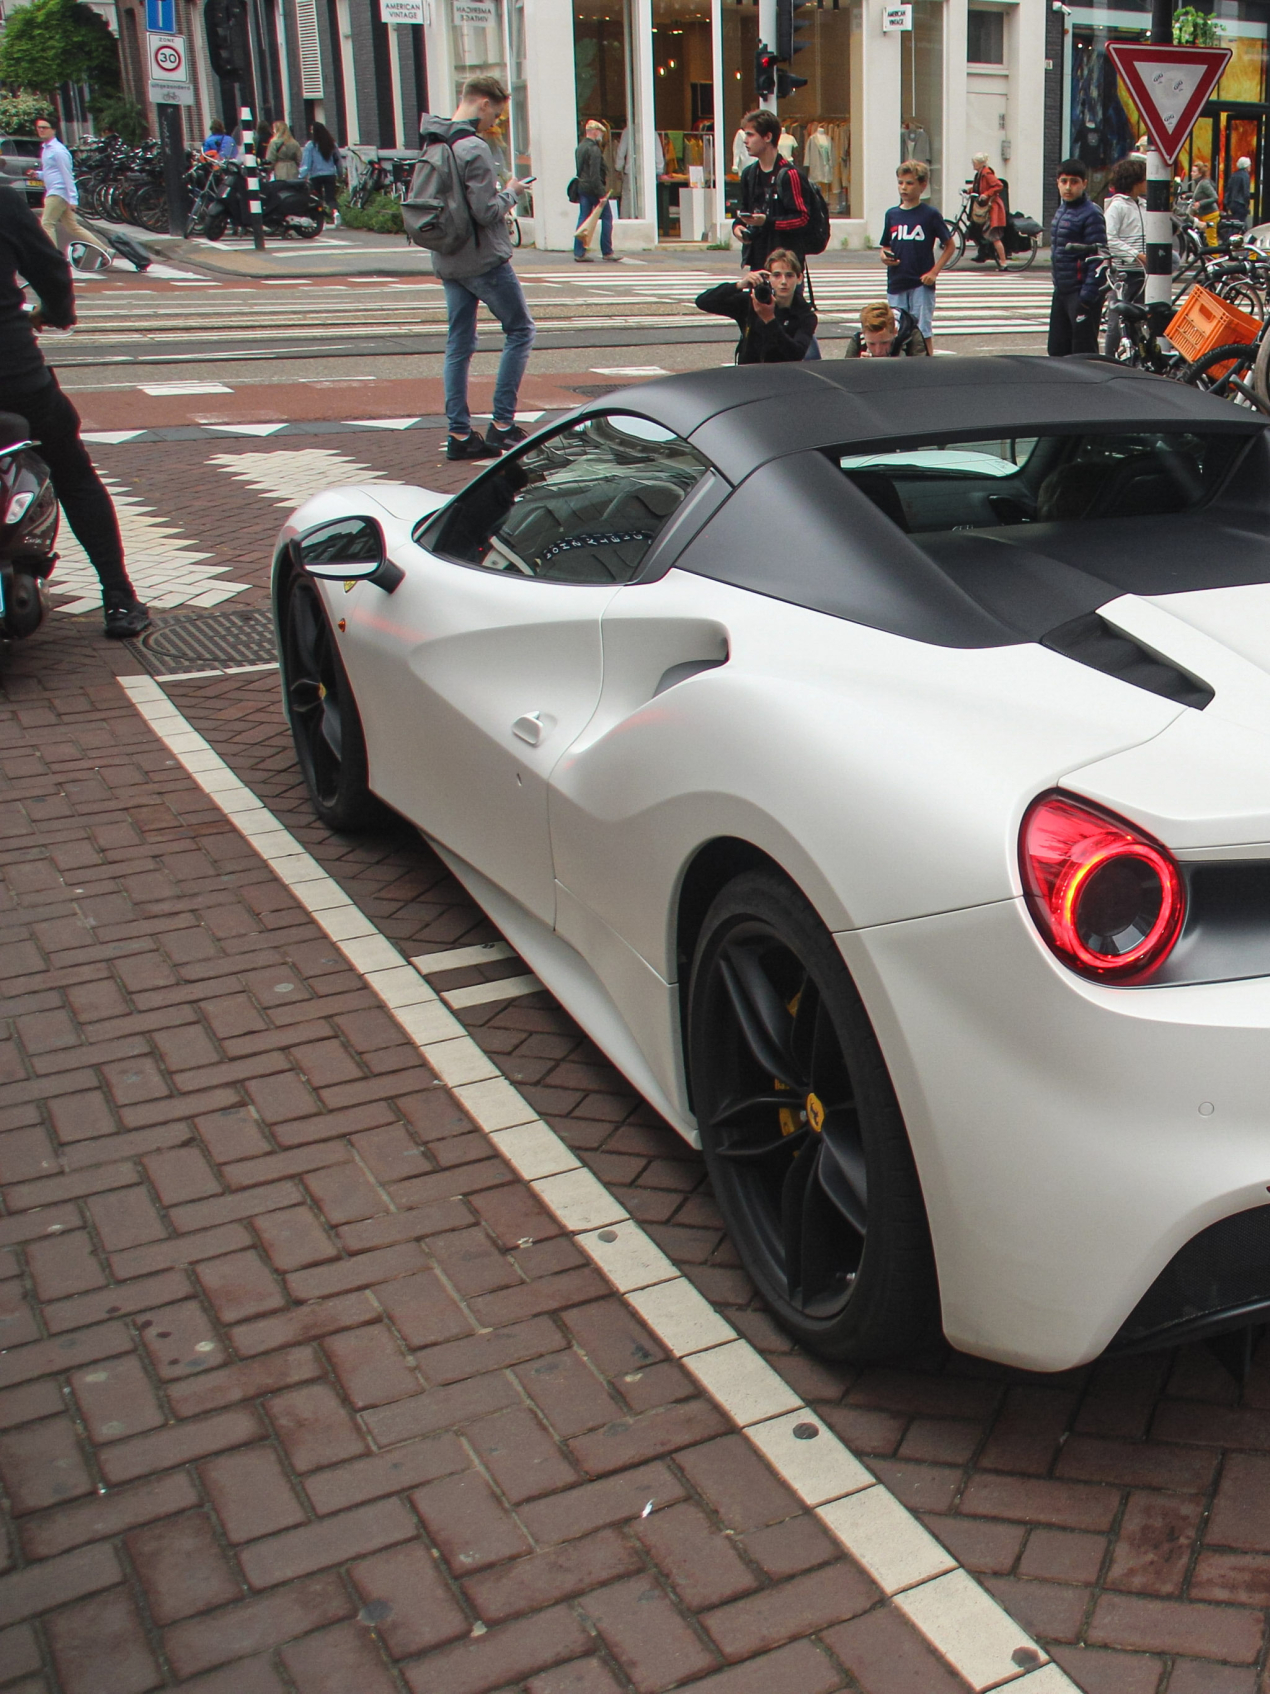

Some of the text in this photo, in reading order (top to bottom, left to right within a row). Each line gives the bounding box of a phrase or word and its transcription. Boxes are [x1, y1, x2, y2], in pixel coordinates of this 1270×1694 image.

[385, 3, 420, 11] AMERICAN
[389, 11, 417, 19] VINTAGE
[159, 53, 177, 63] 30
[890, 225, 925, 240] FILA
